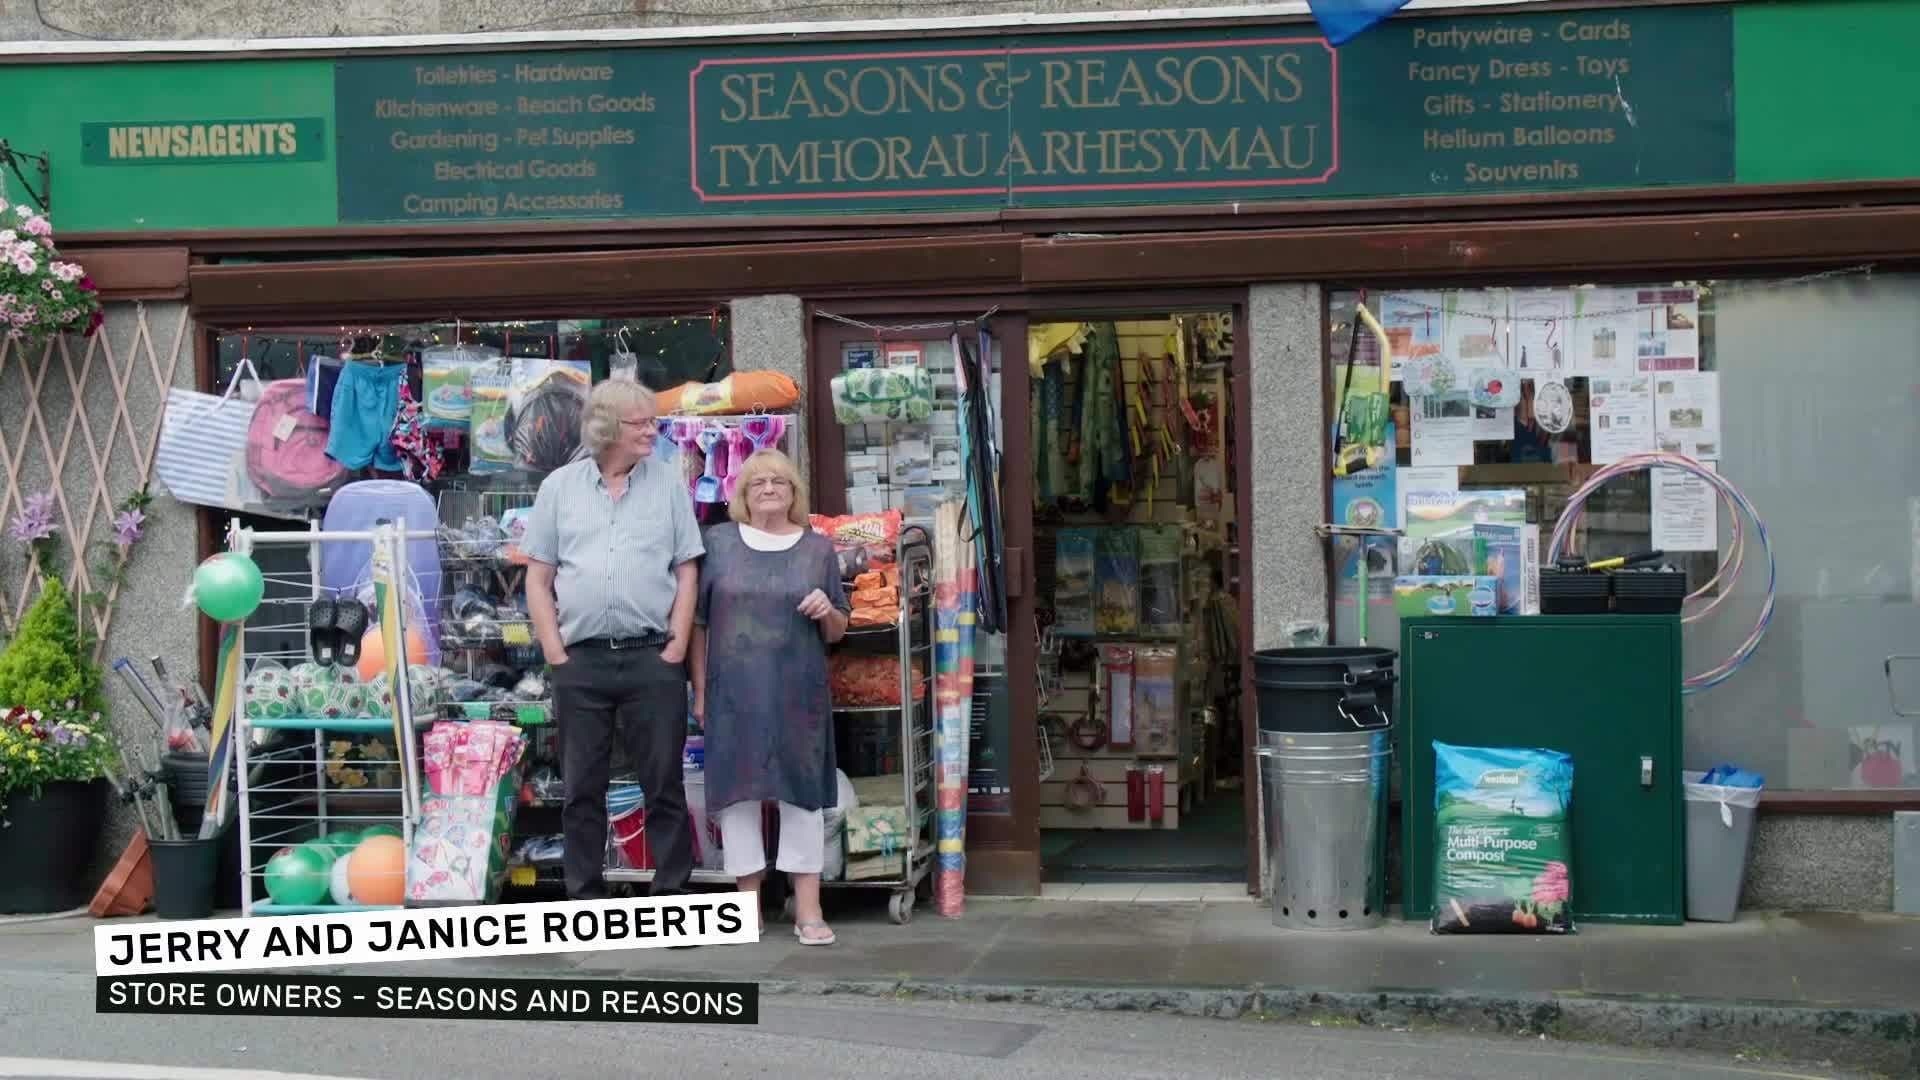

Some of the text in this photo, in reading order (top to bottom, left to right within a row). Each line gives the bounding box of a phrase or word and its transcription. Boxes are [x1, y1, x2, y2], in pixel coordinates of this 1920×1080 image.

[1413, 24, 1533, 50] Partyware
[1559, 20, 1632, 42] Cards
[415, 65, 497, 86] Toiletries
[515, 63, 615, 82] Hardware
[1408, 61, 1481, 84] Fancy
[1489, 57, 1552, 79] Dress
[1576, 55, 1630, 79] Toys
[720, 53, 1303, 123] SEASONS & REASONS
[375, 97, 498, 119] Kitchenware
[516, 94, 583, 114] Beach
[587, 91, 656, 113] Goods
[1424, 95, 1476, 116] Gifts
[1500, 91, 1619, 114] Stationery
[108, 122, 297, 159] NEWSAGENTS
[391, 128, 498, 152] Gardening
[516, 127, 549, 146] Pet
[552, 125, 636, 150] Supplies
[1424, 125, 1616, 150] Helium Balloons
[434, 156, 597, 181] Electrical Goods
[710, 124, 1319, 187] TYMHORAU A RHESYMAU
[1464, 158, 1579, 184] Souvenirs
[403, 188, 626, 215] Camping Accessories
[1447, 836, 1537, 851] Multi-Purpose
[1447, 848, 1505, 864] Compost
